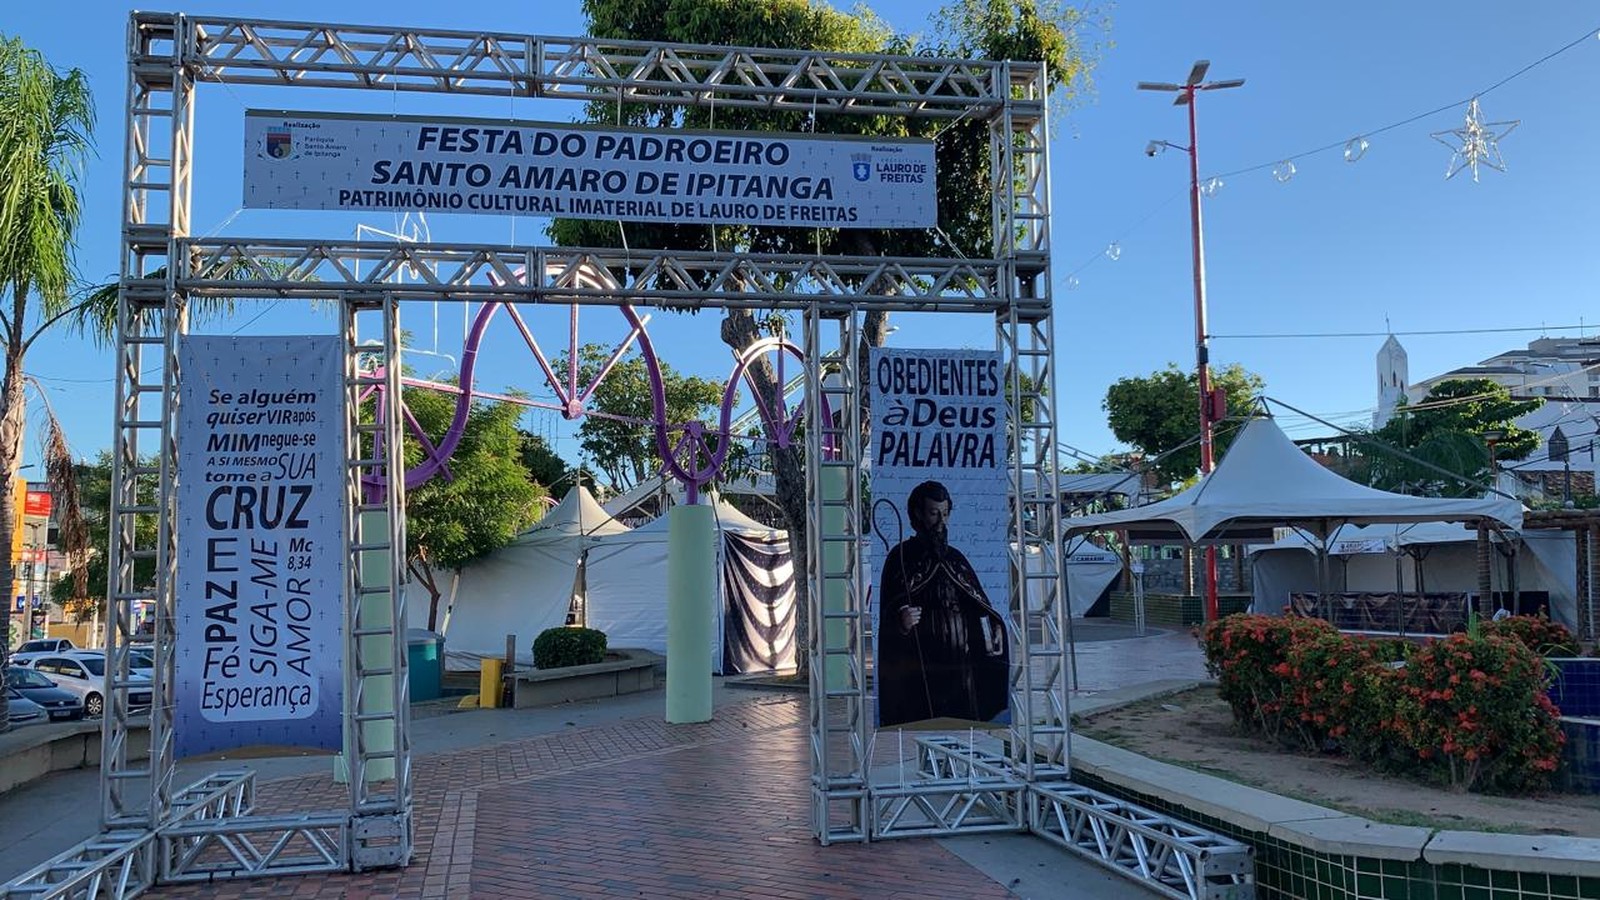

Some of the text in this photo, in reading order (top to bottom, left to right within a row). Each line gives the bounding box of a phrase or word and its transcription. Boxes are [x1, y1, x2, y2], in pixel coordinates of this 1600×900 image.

[417, 126, 789, 166] FESTA DO PADROEIRO
[371, 160, 834, 200] SANTO AMARO DE IPITANGA
[876, 163, 927, 174] LAURO DE
[880, 174, 924, 184] FREITAS
[339, 188, 858, 222] PATRIMÔNIO CULTURAL IMATERIAL DE LAURO DE FREITAS
[877, 356, 999, 396] OBEDIENTES
[208, 388, 316, 408] Se alguém
[882, 398, 996, 428] à Deus
[206, 408, 316, 429] quiser VIR após
[207, 432, 316, 452] MIM negue-se
[878, 431, 995, 468] PALAVRA
[205, 471, 272, 482] tome a
[207, 456, 277, 466] A SI MESMO
[275, 452, 316, 480] SUA
[206, 485, 313, 530] CRUZ
[207, 537, 239, 572] E
[289, 538, 313, 552] Mc
[287, 556, 312, 572] 8,34
[205, 580, 238, 643] PAZ
[250, 538, 278, 677] SIGA-ME
[286, 578, 312, 677] AMOR
[203, 646, 240, 679] Fé
[202, 681, 312, 716] Esperança
